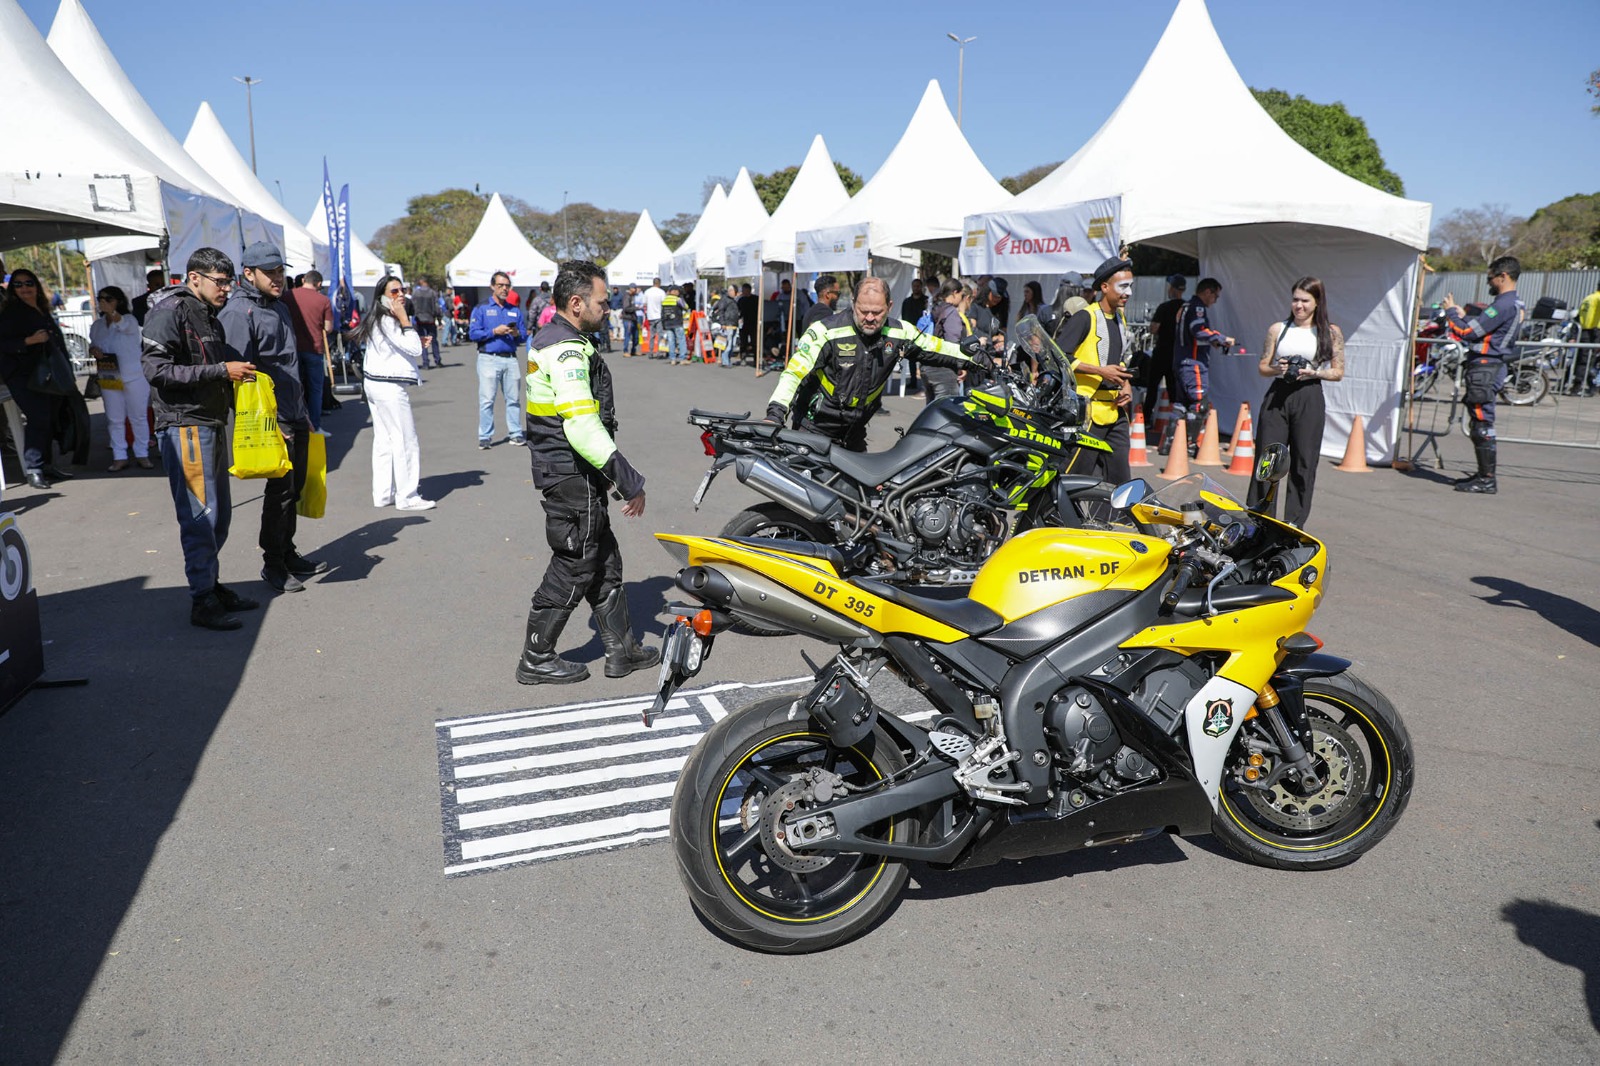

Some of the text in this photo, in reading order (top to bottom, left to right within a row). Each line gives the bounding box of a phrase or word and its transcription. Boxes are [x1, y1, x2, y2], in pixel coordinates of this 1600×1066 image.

[1009, 237, 1071, 254] HONDA
[1009, 428, 1061, 449] DETRAN
[929, 517, 939, 526] T
[1018, 565, 1084, 584] DETRAN
[1100, 561, 1119, 575] DF
[813, 581, 875, 617] DT 395
